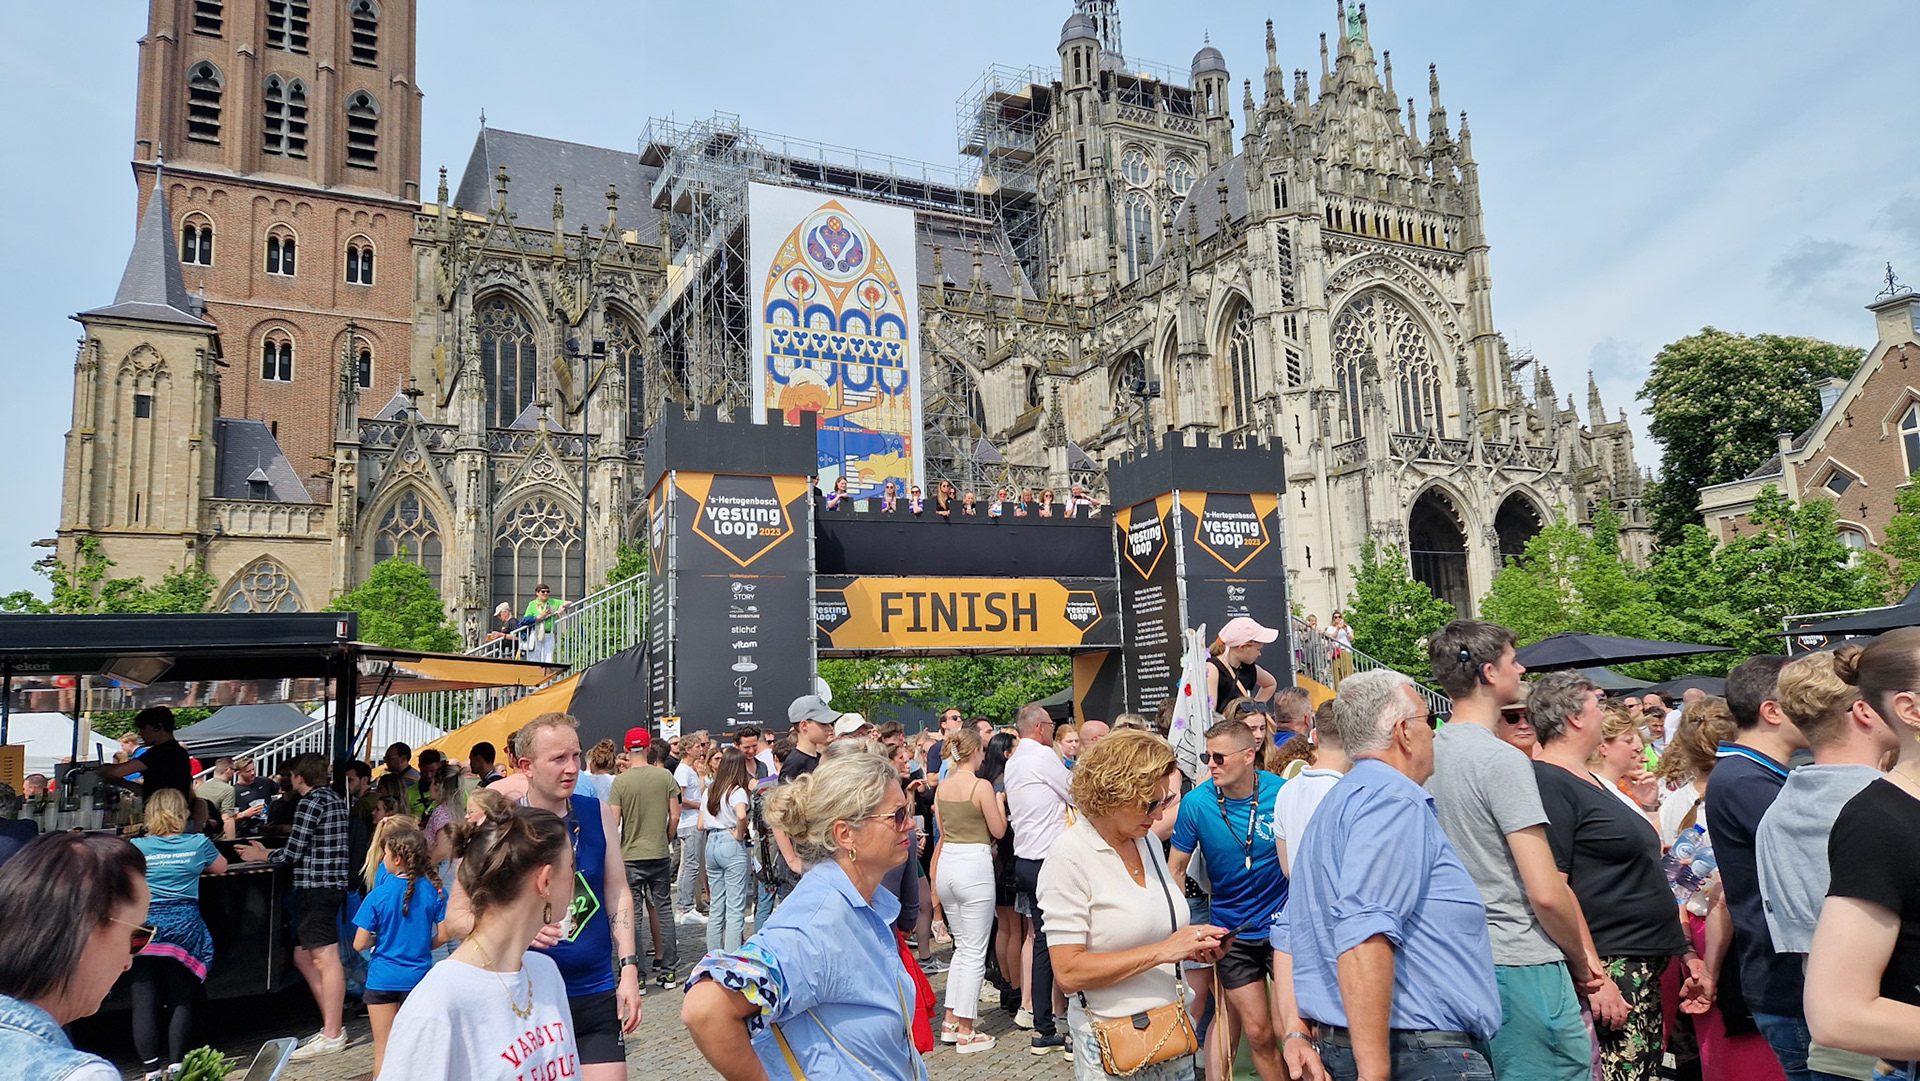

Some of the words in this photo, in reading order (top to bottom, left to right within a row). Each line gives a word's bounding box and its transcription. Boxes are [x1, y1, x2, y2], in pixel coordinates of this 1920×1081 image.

[708, 496, 778, 506] 's-Hertogenbosch
[706, 507, 780, 526] vesting
[1204, 511, 1256, 520] 's-Hertogenbosch
[714, 520, 758, 539] loop
[759, 528, 782, 536] 2023
[1128, 525, 1161, 545] vesting
[1202, 521, 1260, 537] vesting
[1210, 532, 1243, 549] loop
[1132, 541, 1152, 556] loop
[816, 606, 848, 616] esting
[880, 591, 1038, 633] FINISH
[1066, 606, 1097, 616] vesting
[816, 613, 837, 622] loop
[1070, 613, 1088, 622] loop
[731, 626, 757, 634] stichd
